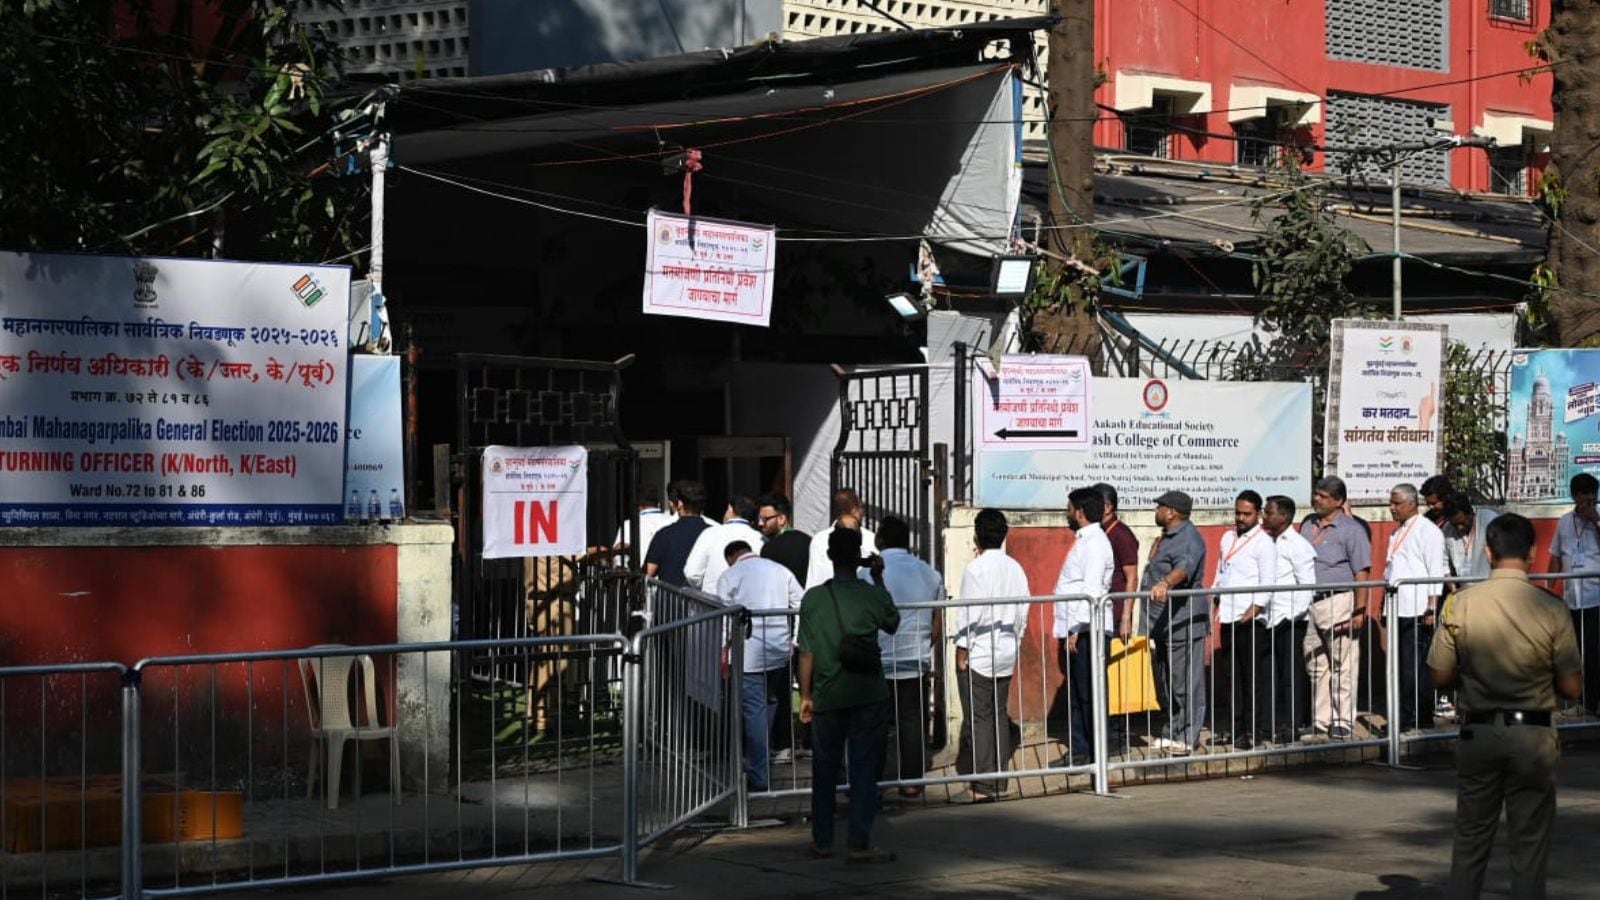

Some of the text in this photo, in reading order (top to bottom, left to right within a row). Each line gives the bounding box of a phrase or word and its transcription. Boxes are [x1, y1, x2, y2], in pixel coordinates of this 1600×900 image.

[2, 315, 339, 347] महानगरपालिका सार्वत्रिक निवडणूक २०२५-२०२६
[27, 350, 81, 375] निर्णय
[88, 352, 170, 378] अधिकारी
[126, 392, 144, 404] ७२
[148, 389, 158, 404] ते
[162, 393, 177, 404] ८१
[182, 393, 190, 404] व
[194, 394, 209, 406] ८६
[1362, 407, 1378, 418] कर
[33, 415, 152, 444] Mahanagarpalika
[156, 418, 207, 441] General
[212, 419, 263, 442] Election
[268, 420, 338, 443] 2025-2026
[1092, 420, 1214, 431] Aakash Educational Society
[1092, 433, 1239, 448] ash College of Commerce
[1344, 426, 1434, 443] सांगतंय संविधान!
[80, 452, 154, 472] OFFICER
[161, 452, 234, 476] (K/North,
[240, 454, 296, 478] K/East)
[70, 484, 205, 497] Ward No.72 to 81 & 86
[513, 500, 558, 544] IN
